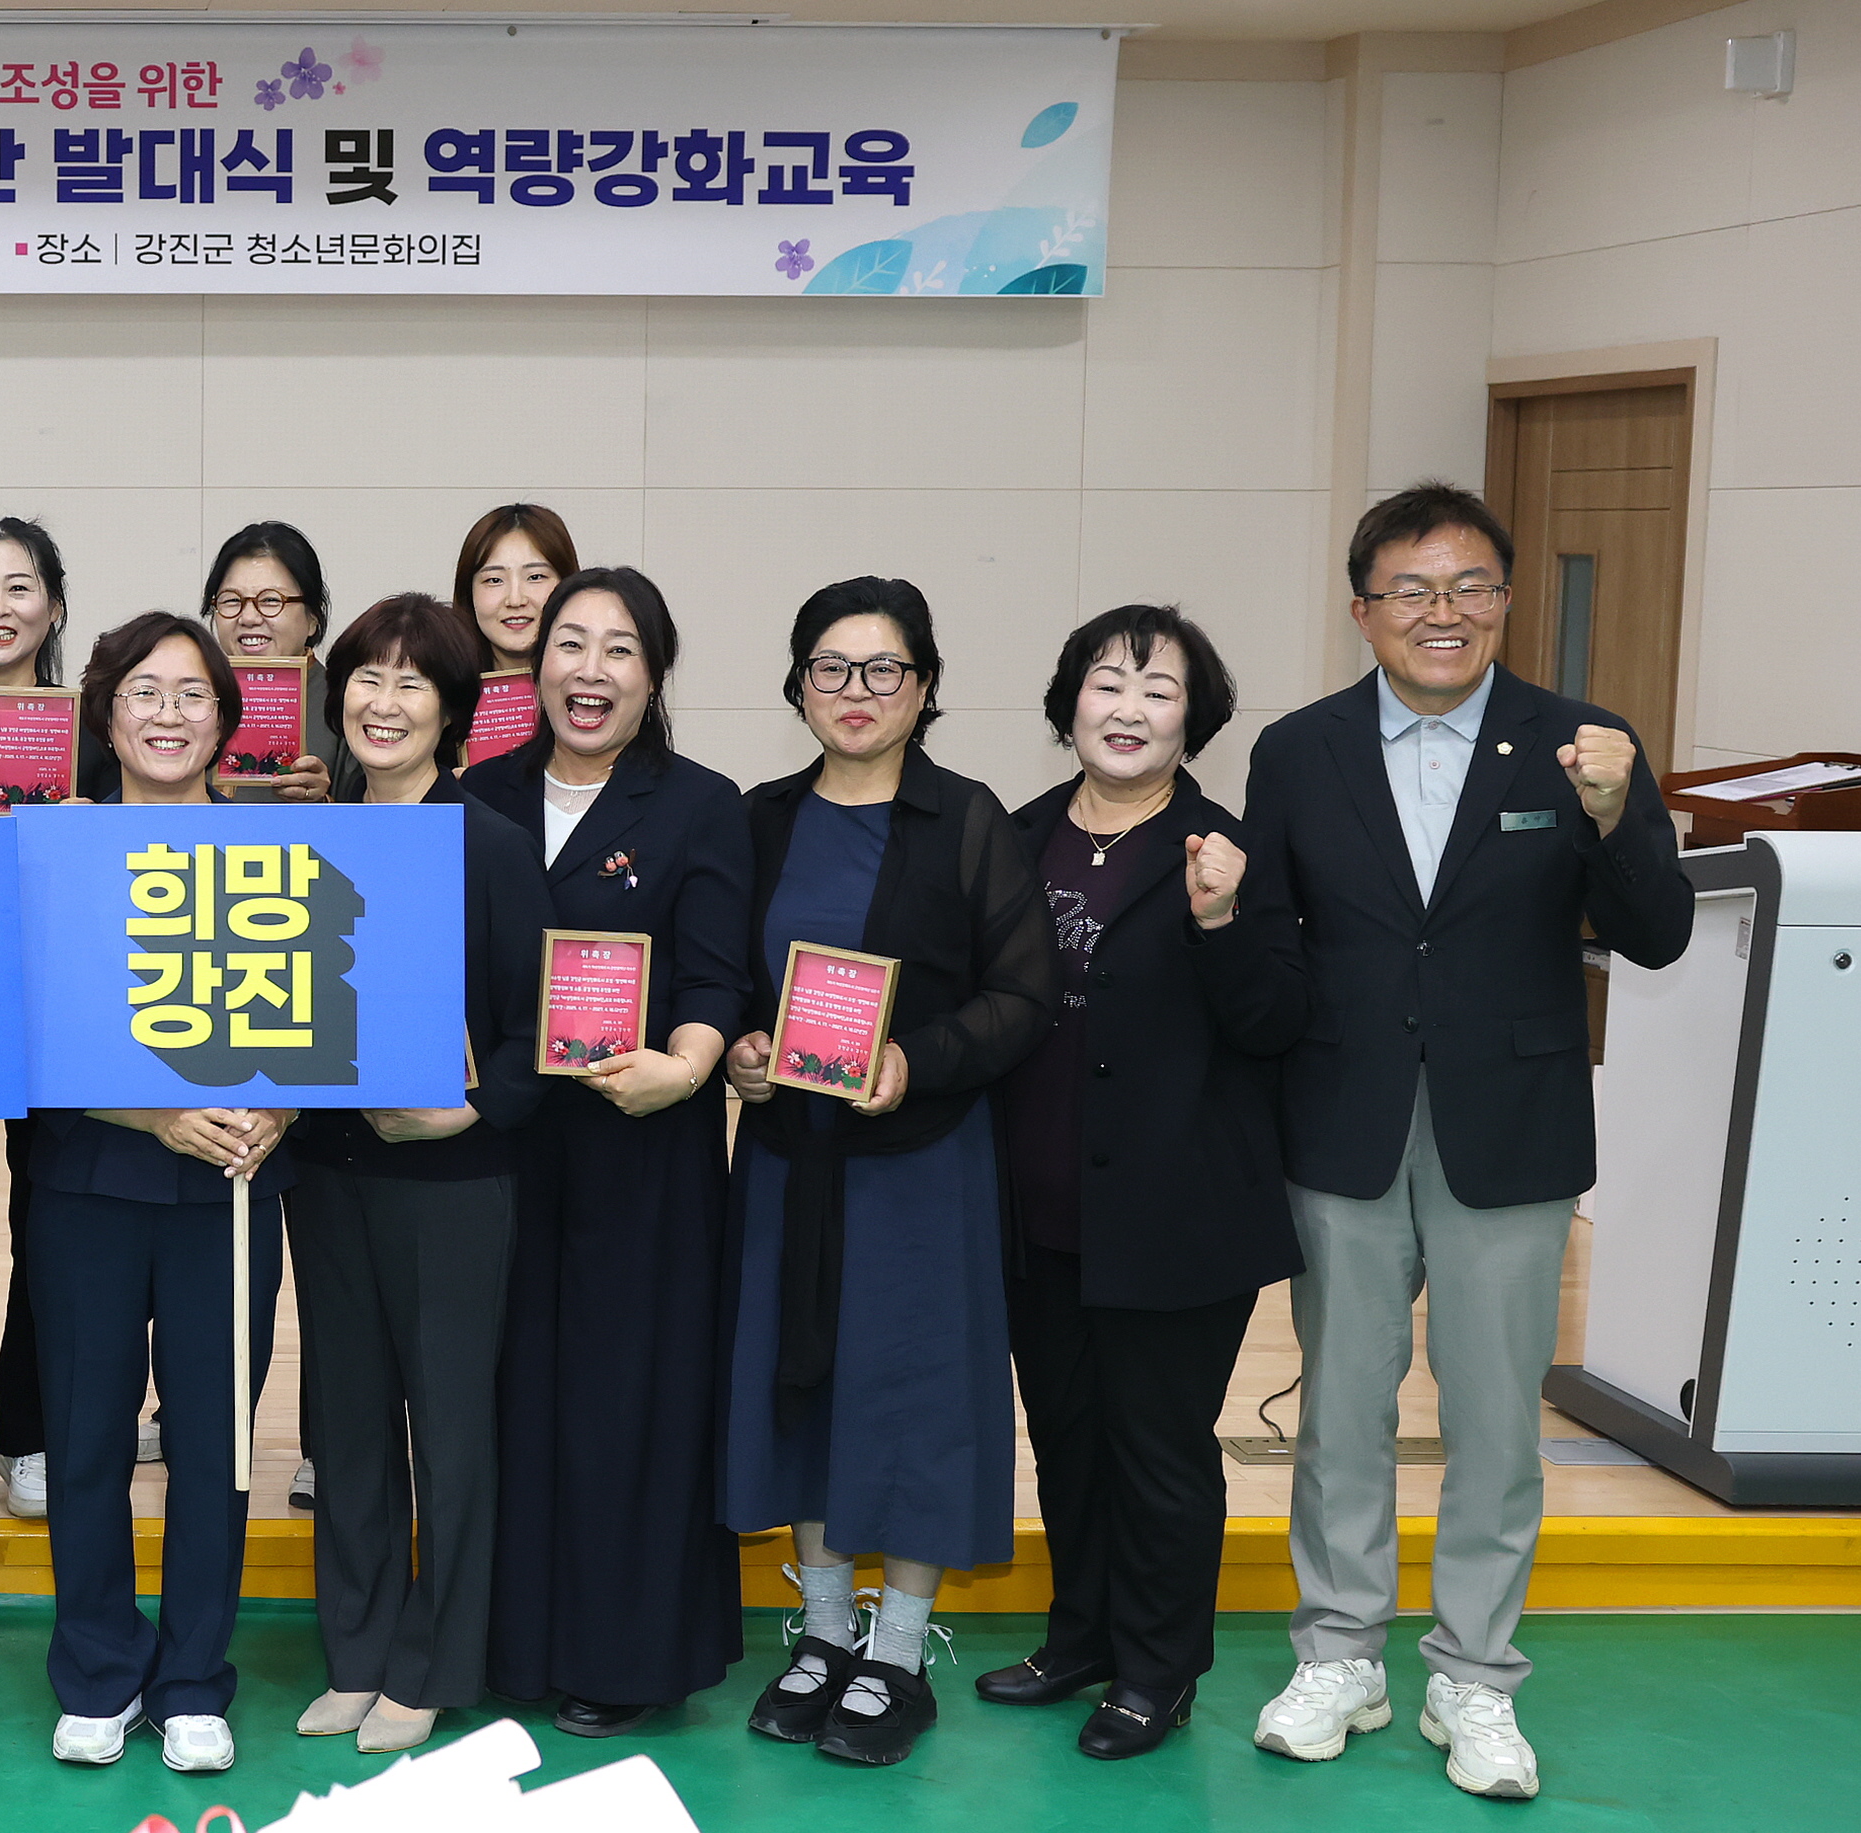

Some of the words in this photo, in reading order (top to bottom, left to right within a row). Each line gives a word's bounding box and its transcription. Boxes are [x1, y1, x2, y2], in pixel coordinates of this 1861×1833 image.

[137, 61, 223, 109] 위한
[53, 128, 293, 204] 발대식
[324, 128, 399, 206] 및
[423, 128, 915, 208] 역량강화교육
[36, 233, 102, 265] 장소
[135, 233, 234, 265] 강진군
[247, 232, 481, 266] 청소년문화의집
[128, 844, 320, 941] 희망
[129, 951, 313, 1049] 강진
